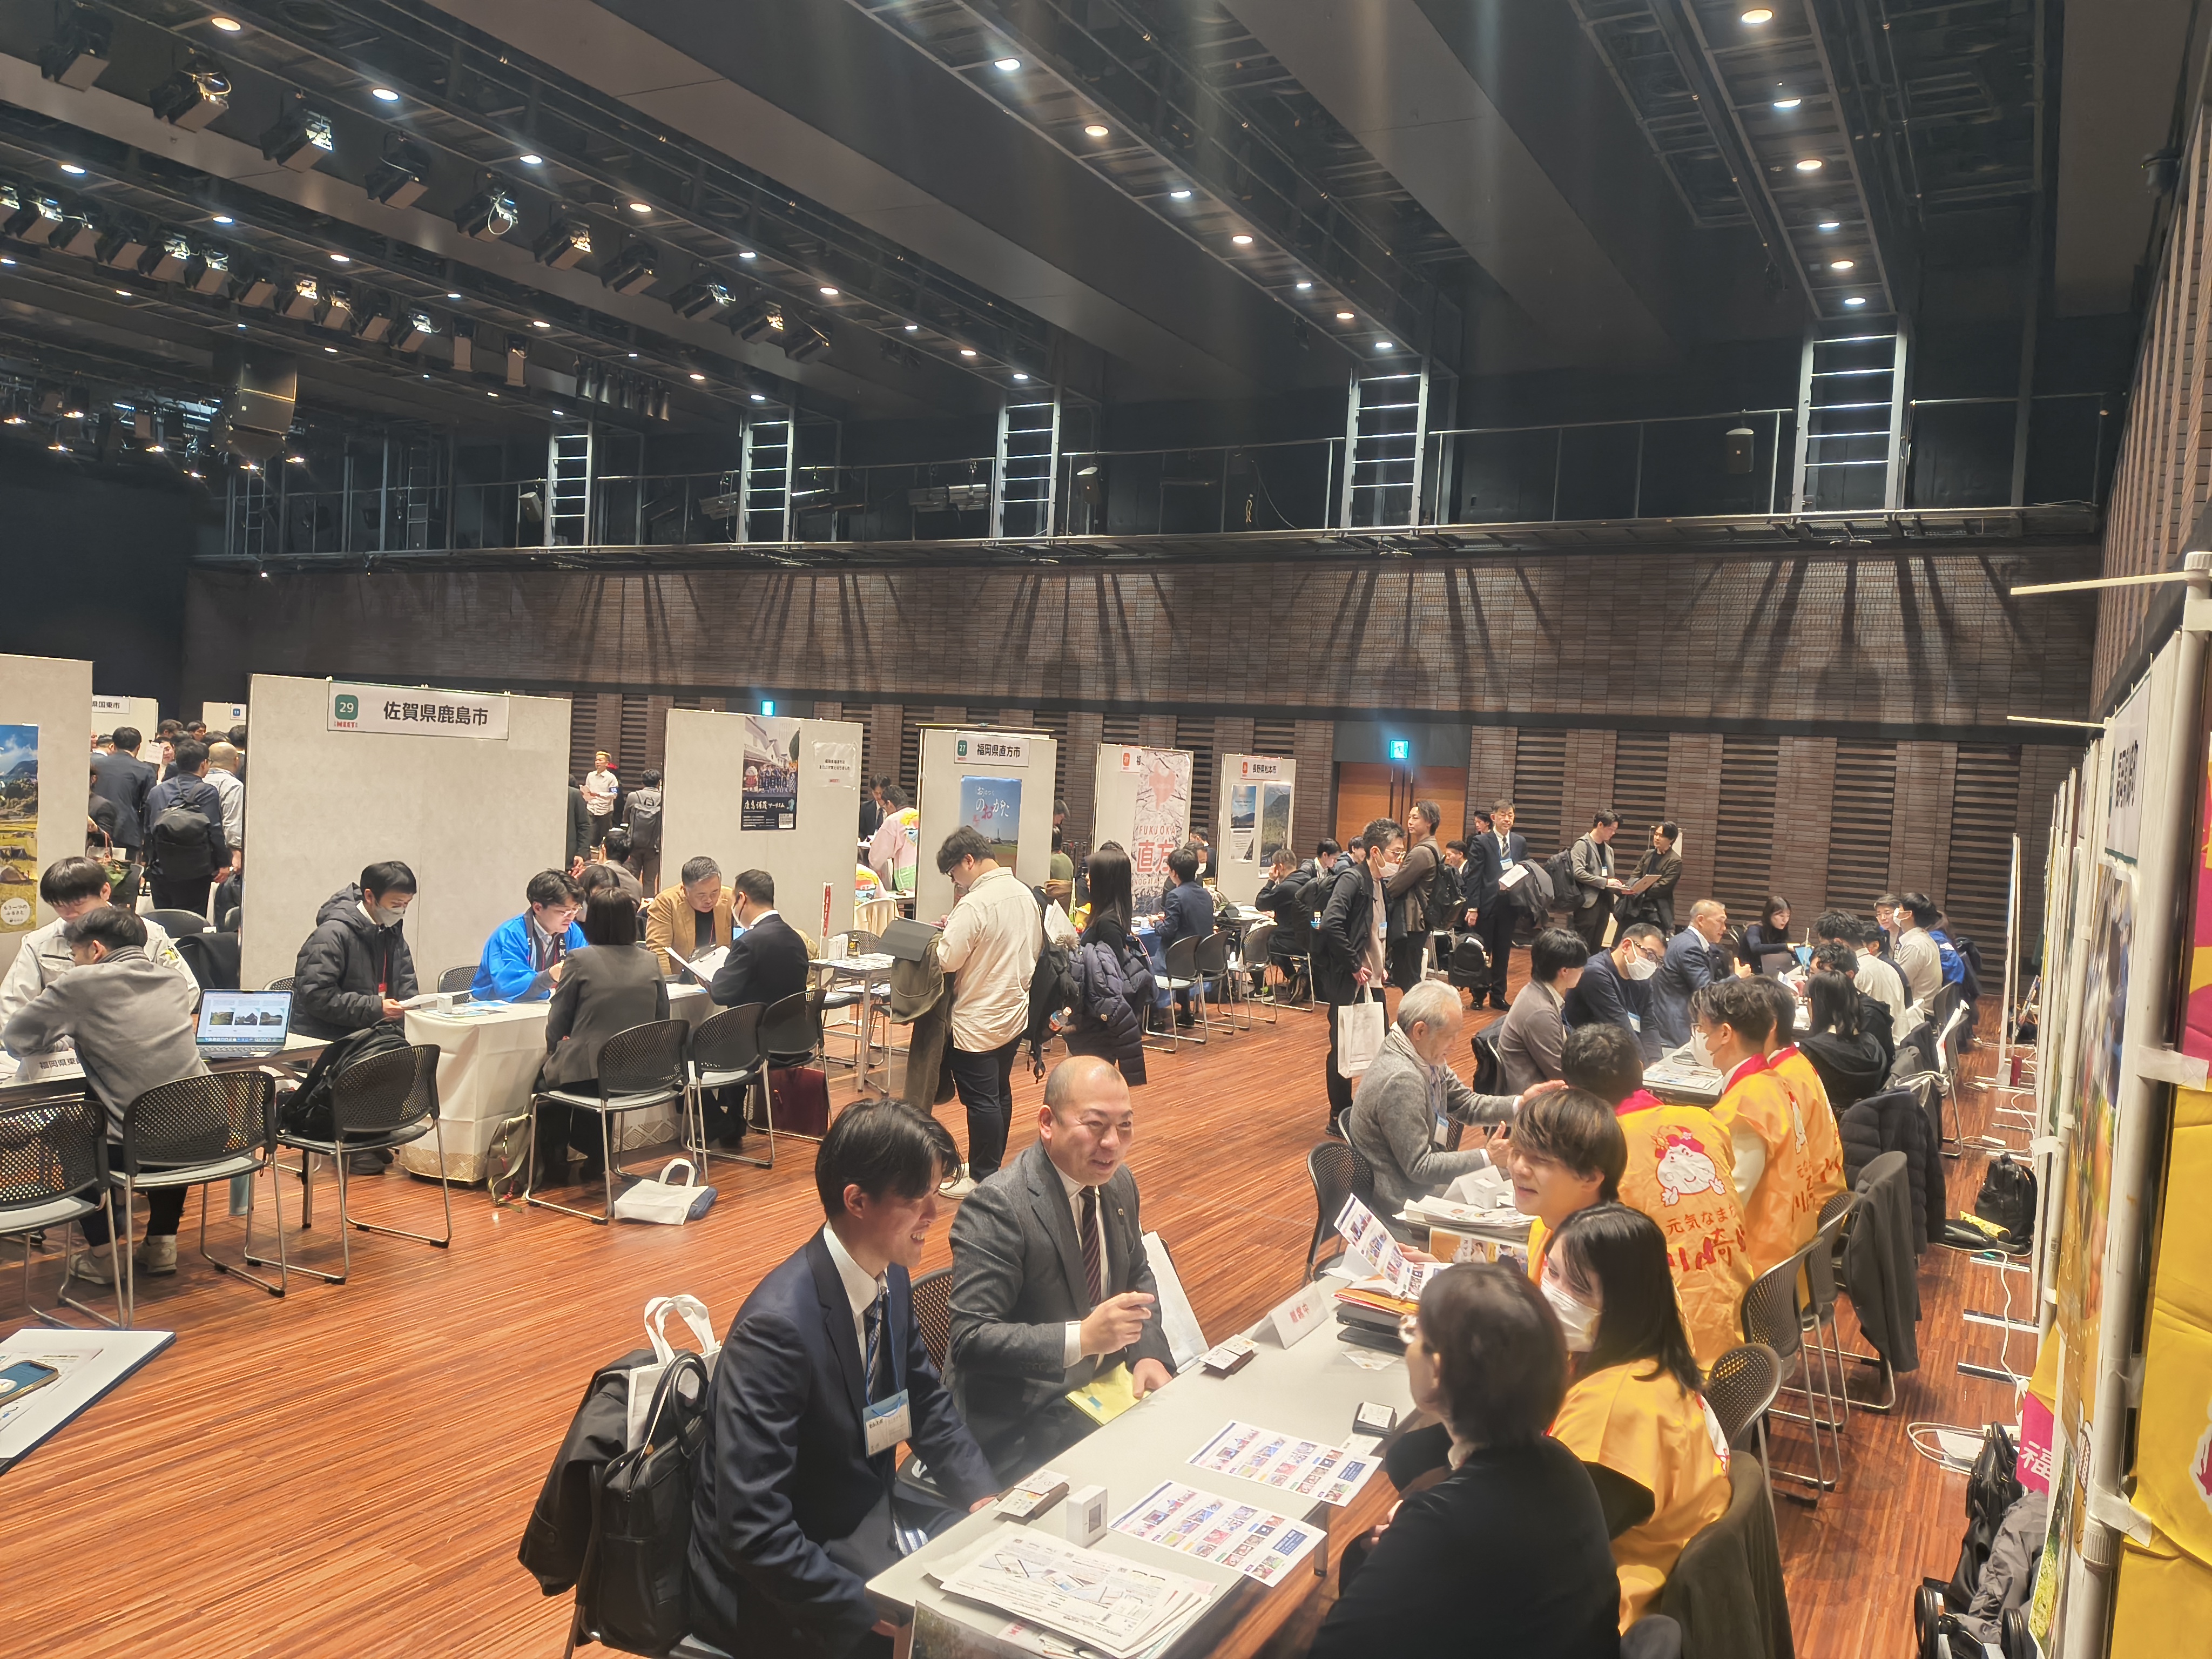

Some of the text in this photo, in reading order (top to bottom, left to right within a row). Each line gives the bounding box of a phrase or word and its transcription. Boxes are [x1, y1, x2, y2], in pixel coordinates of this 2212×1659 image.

[339, 702, 354, 713] 29
[383, 700, 489, 726] 佐賀県鹿島市
[977, 743, 1021, 758] 福岡県直方市
[1138, 825, 1176, 835] FUKUOKA
[1137, 839, 1174, 873] 直方
[1666, 1204, 1737, 1236] 元気なまち
